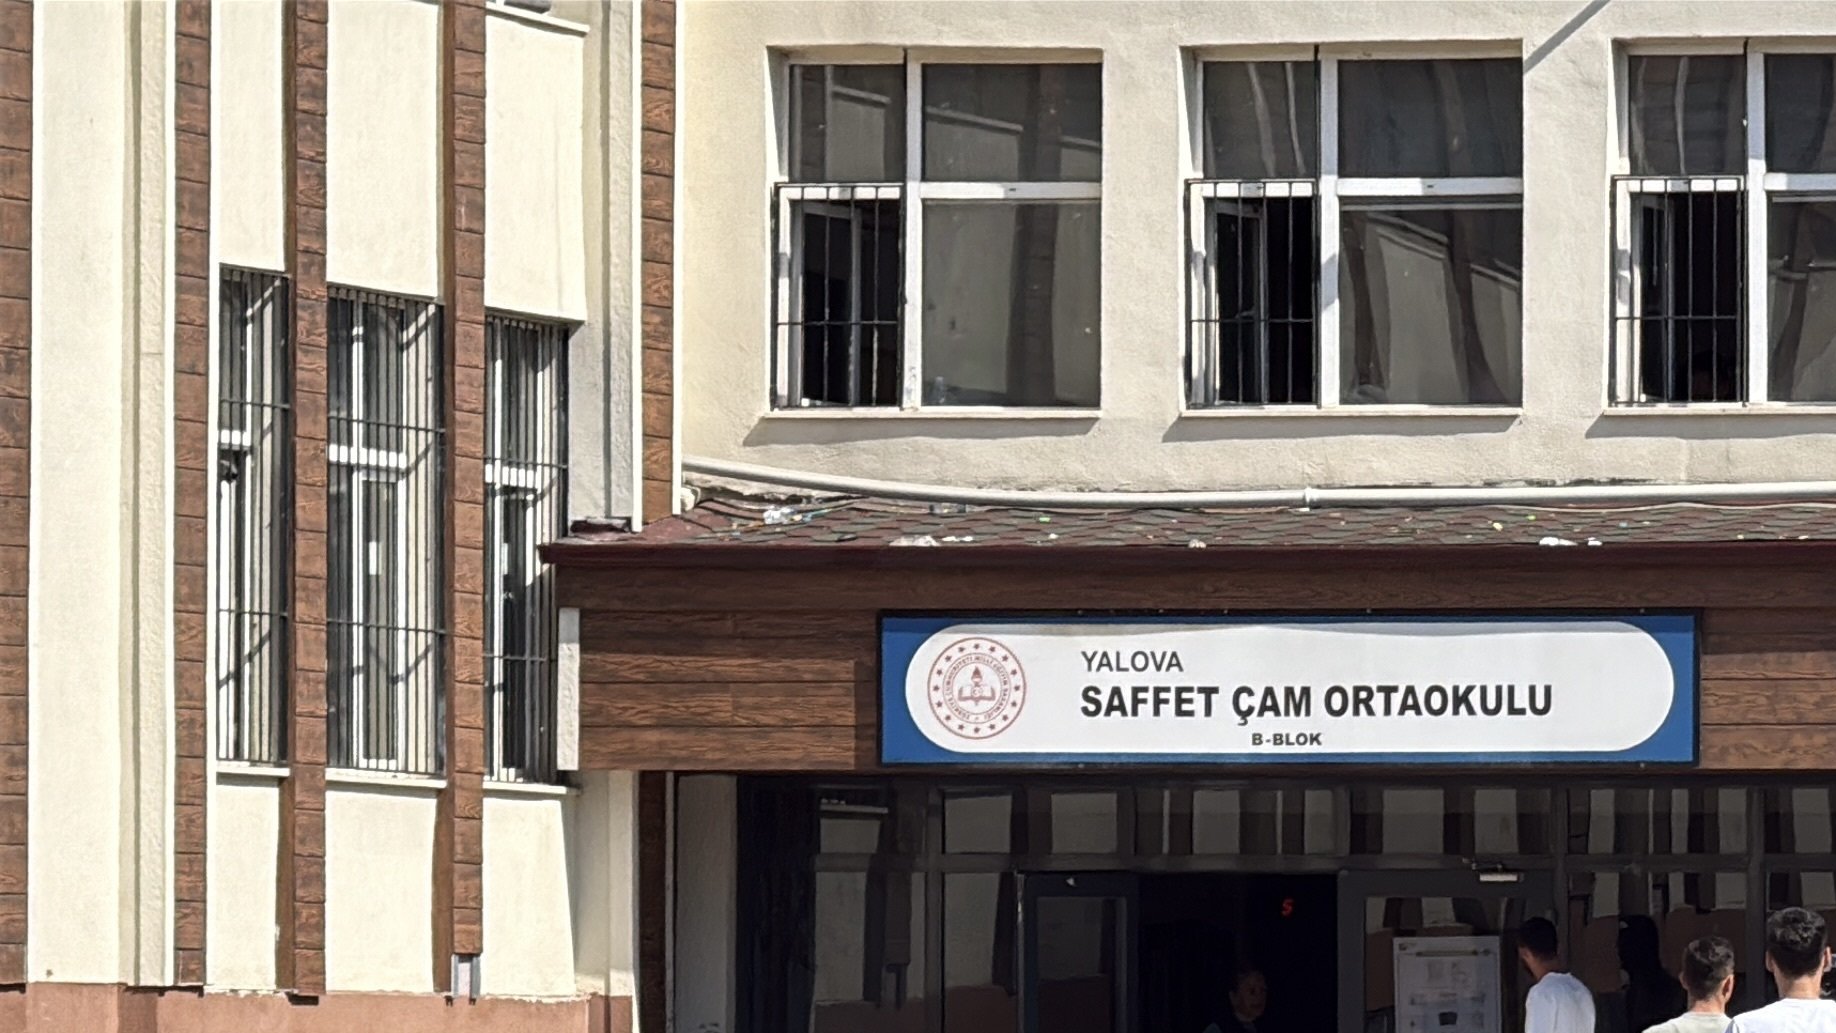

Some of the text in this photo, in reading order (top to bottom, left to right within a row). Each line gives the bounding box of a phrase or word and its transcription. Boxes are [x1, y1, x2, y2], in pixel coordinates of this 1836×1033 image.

[1081, 650, 1184, 672] YALOVA
[1081, 684, 1553, 726] SAFFET ÇAM ORTAOKULU
[1252, 732, 1322, 746] B-BLOK
